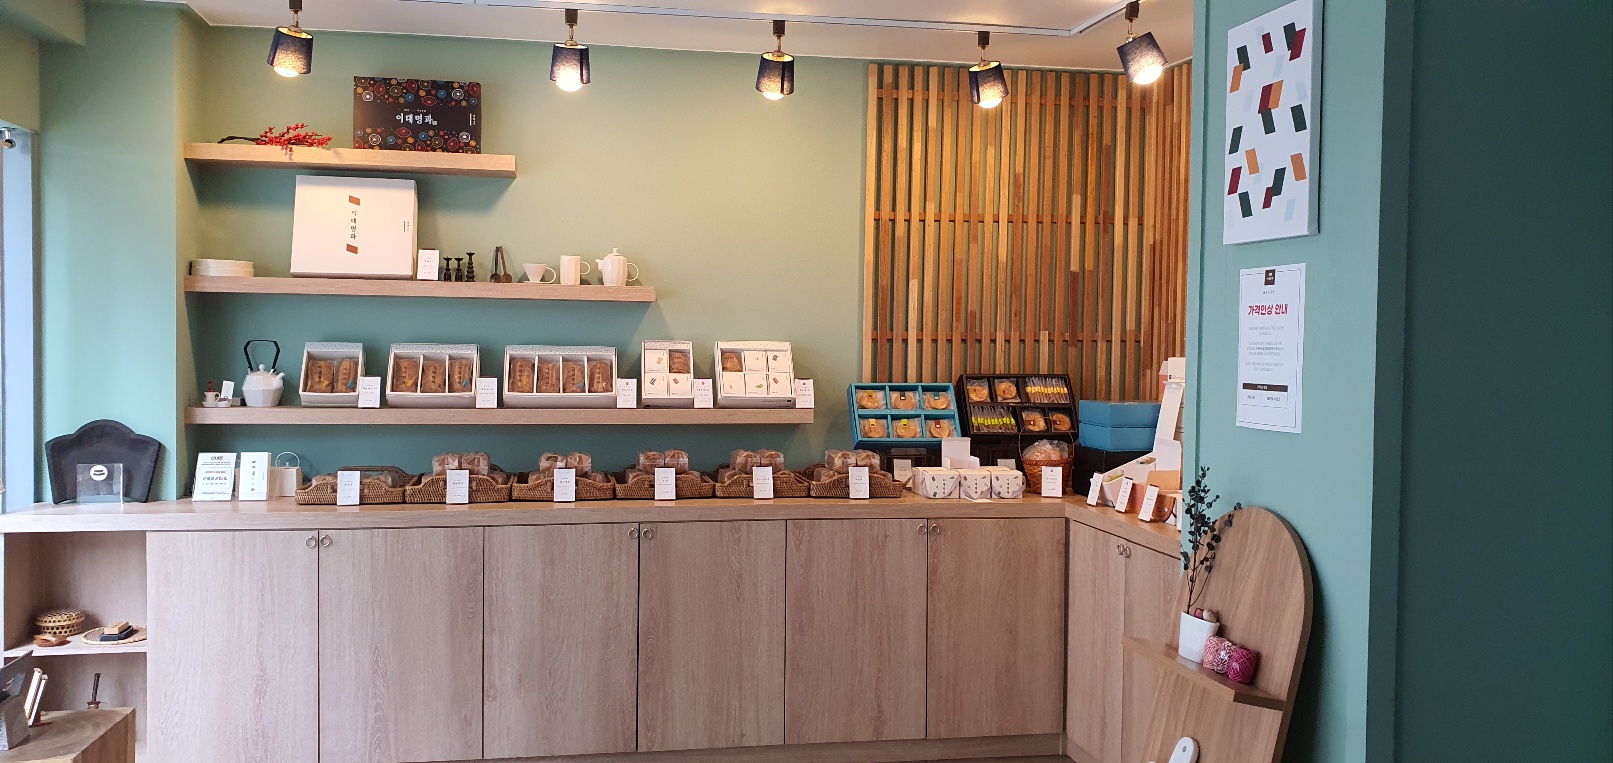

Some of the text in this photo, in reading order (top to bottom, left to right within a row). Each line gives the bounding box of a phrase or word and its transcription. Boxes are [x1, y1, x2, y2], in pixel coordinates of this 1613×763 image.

[395, 113, 433, 125] 이대명과
[1248, 304, 1289, 316] 가격인상 안내
